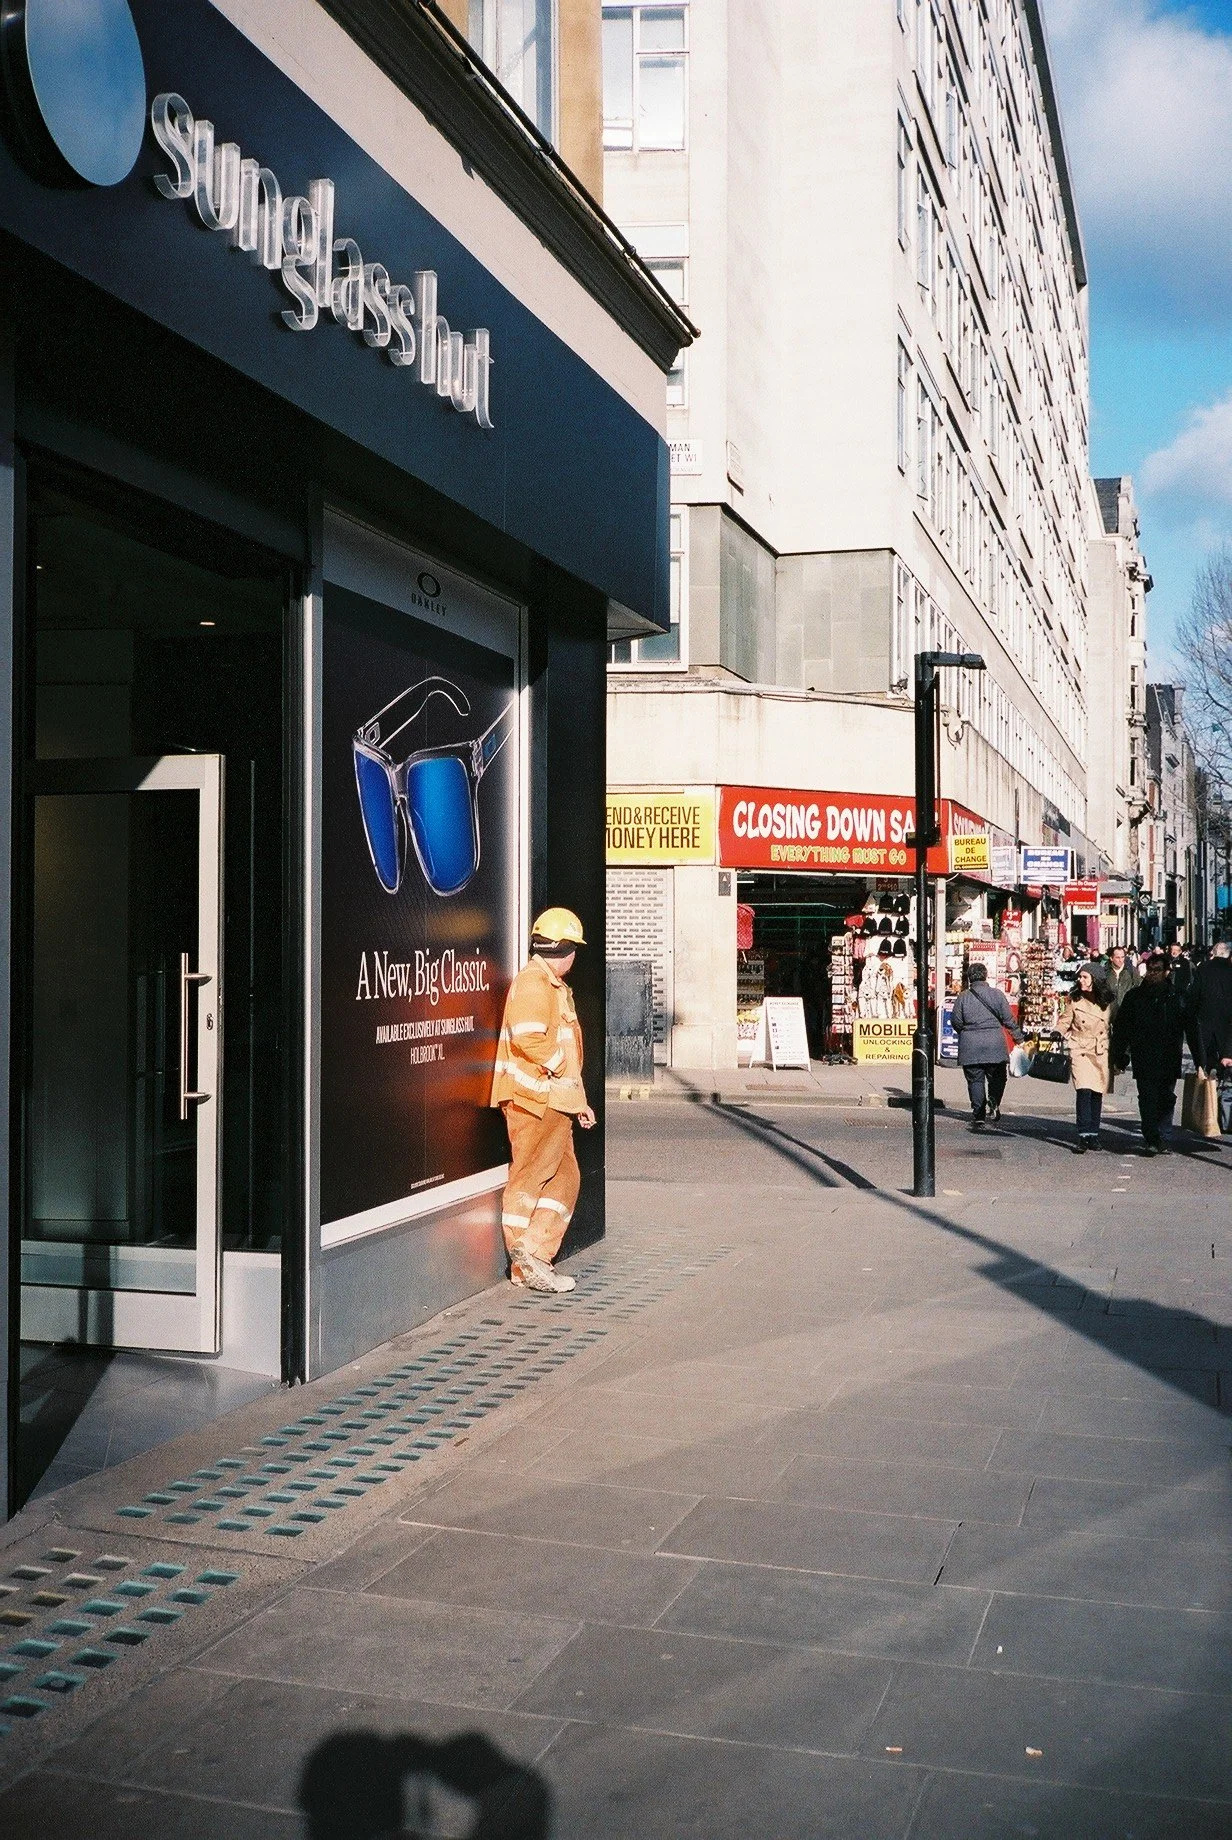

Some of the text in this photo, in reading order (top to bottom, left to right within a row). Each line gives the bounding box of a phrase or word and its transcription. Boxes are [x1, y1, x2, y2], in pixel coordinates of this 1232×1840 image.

[732, 800, 822, 840] CLOSING
[826, 805, 886, 843] DOWN
[659, 827, 700, 849] HERE
[954, 838, 986, 846] BUREAU
[770, 844, 907, 866] EVERYTHING MUST GO
[955, 855, 987, 863] CHANGE
[355, 948, 490, 1006] A New, Big Classic.
[376, 1023, 404, 1044] AVAILABLE
[403, 1020, 435, 1040] EXCLUSIVELY
[434, 1019, 441, 1036] AT
[441, 1017, 465, 1035] SUNGLASS
[859, 1023, 917, 1036] MOBILE
